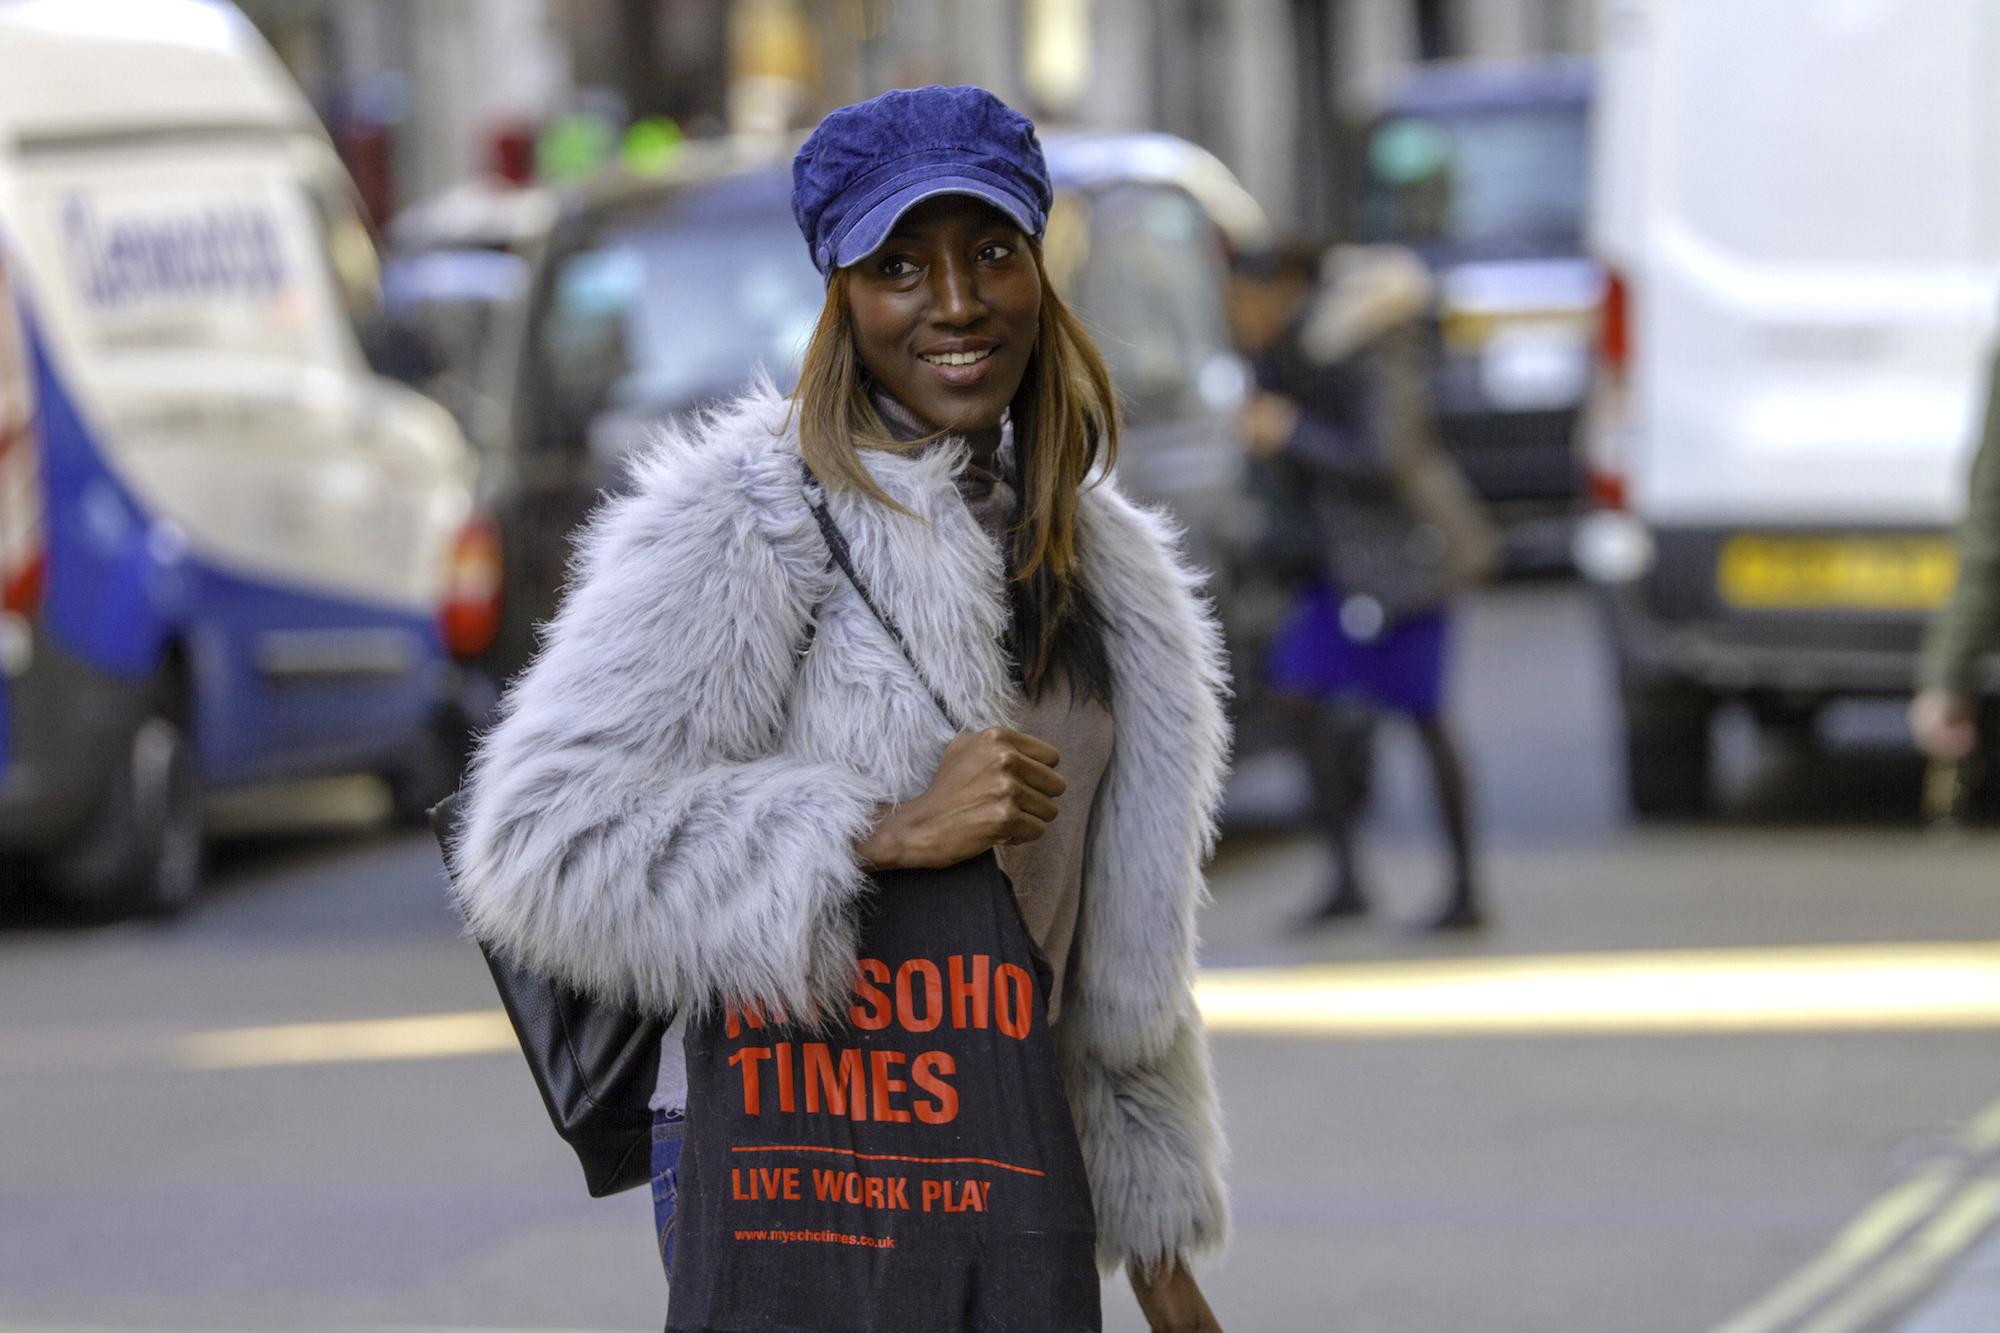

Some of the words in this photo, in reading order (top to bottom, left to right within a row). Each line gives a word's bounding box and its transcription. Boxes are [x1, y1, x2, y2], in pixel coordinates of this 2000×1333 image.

[849, 954, 1033, 1041] SOHO
[728, 1042, 959, 1125] TIMES
[731, 1167, 801, 1201] LIVE
[812, 1168, 910, 1210] WORK
[921, 1179, 992, 1213] PLAY
[734, 1228, 896, 1249] www.mysohotimes.co.uk
